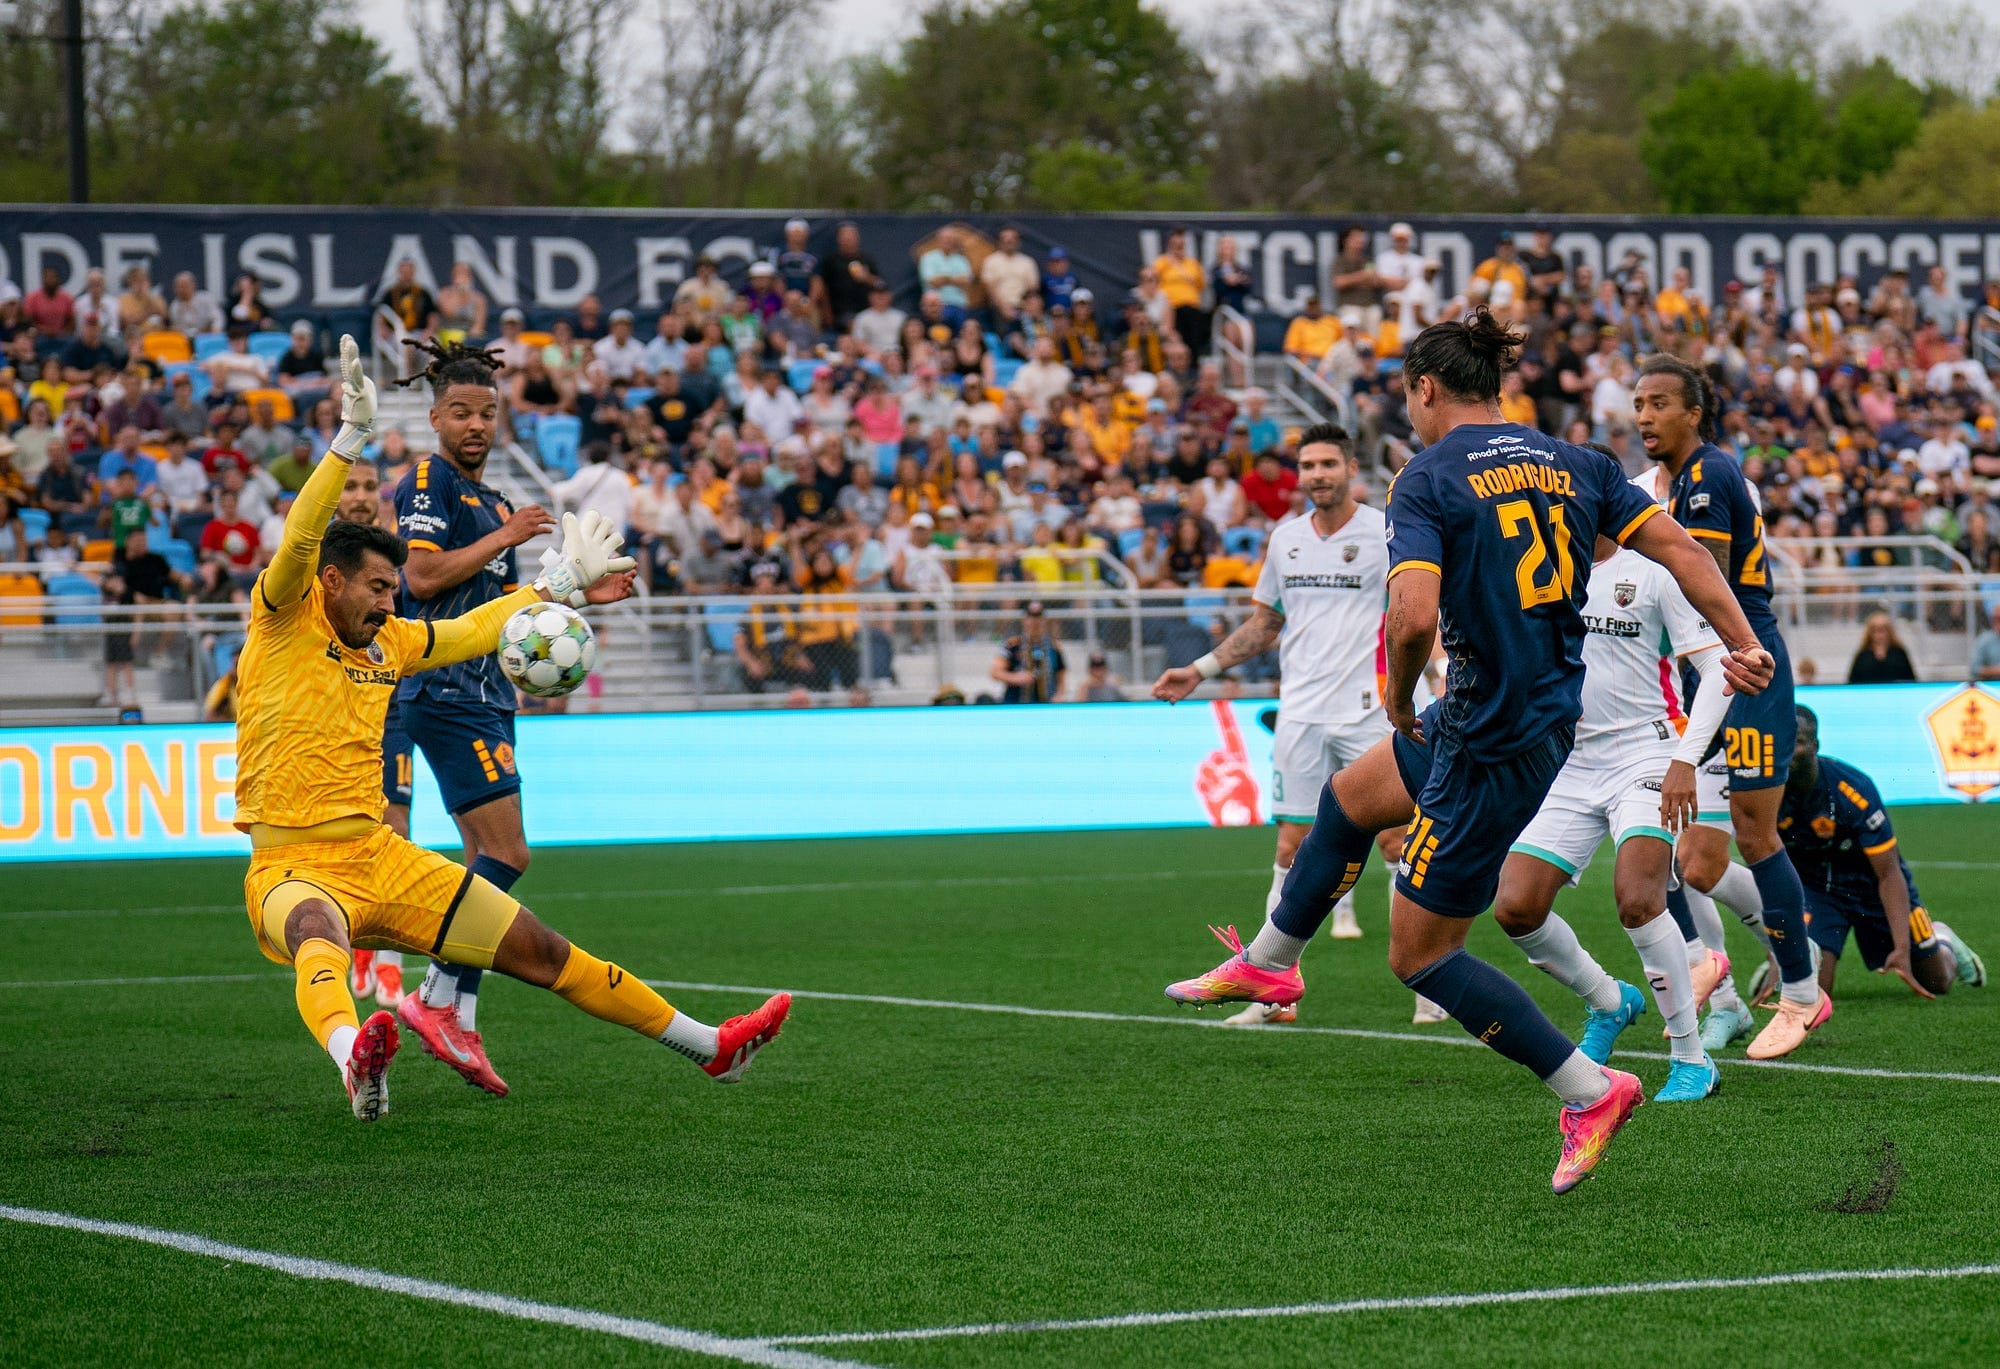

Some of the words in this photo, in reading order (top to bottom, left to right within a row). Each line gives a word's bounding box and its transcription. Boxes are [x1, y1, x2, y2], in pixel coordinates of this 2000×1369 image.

[0, 233, 162, 304] DE
[202, 233, 598, 309] ISLAND
[1467, 448, 1498, 461] Rhode
[1467, 462, 1576, 499] RODRIGUEZ
[1496, 500, 1574, 610] 21
[1605, 617, 1642, 632] FIRST
[1725, 726, 1761, 768] 20
